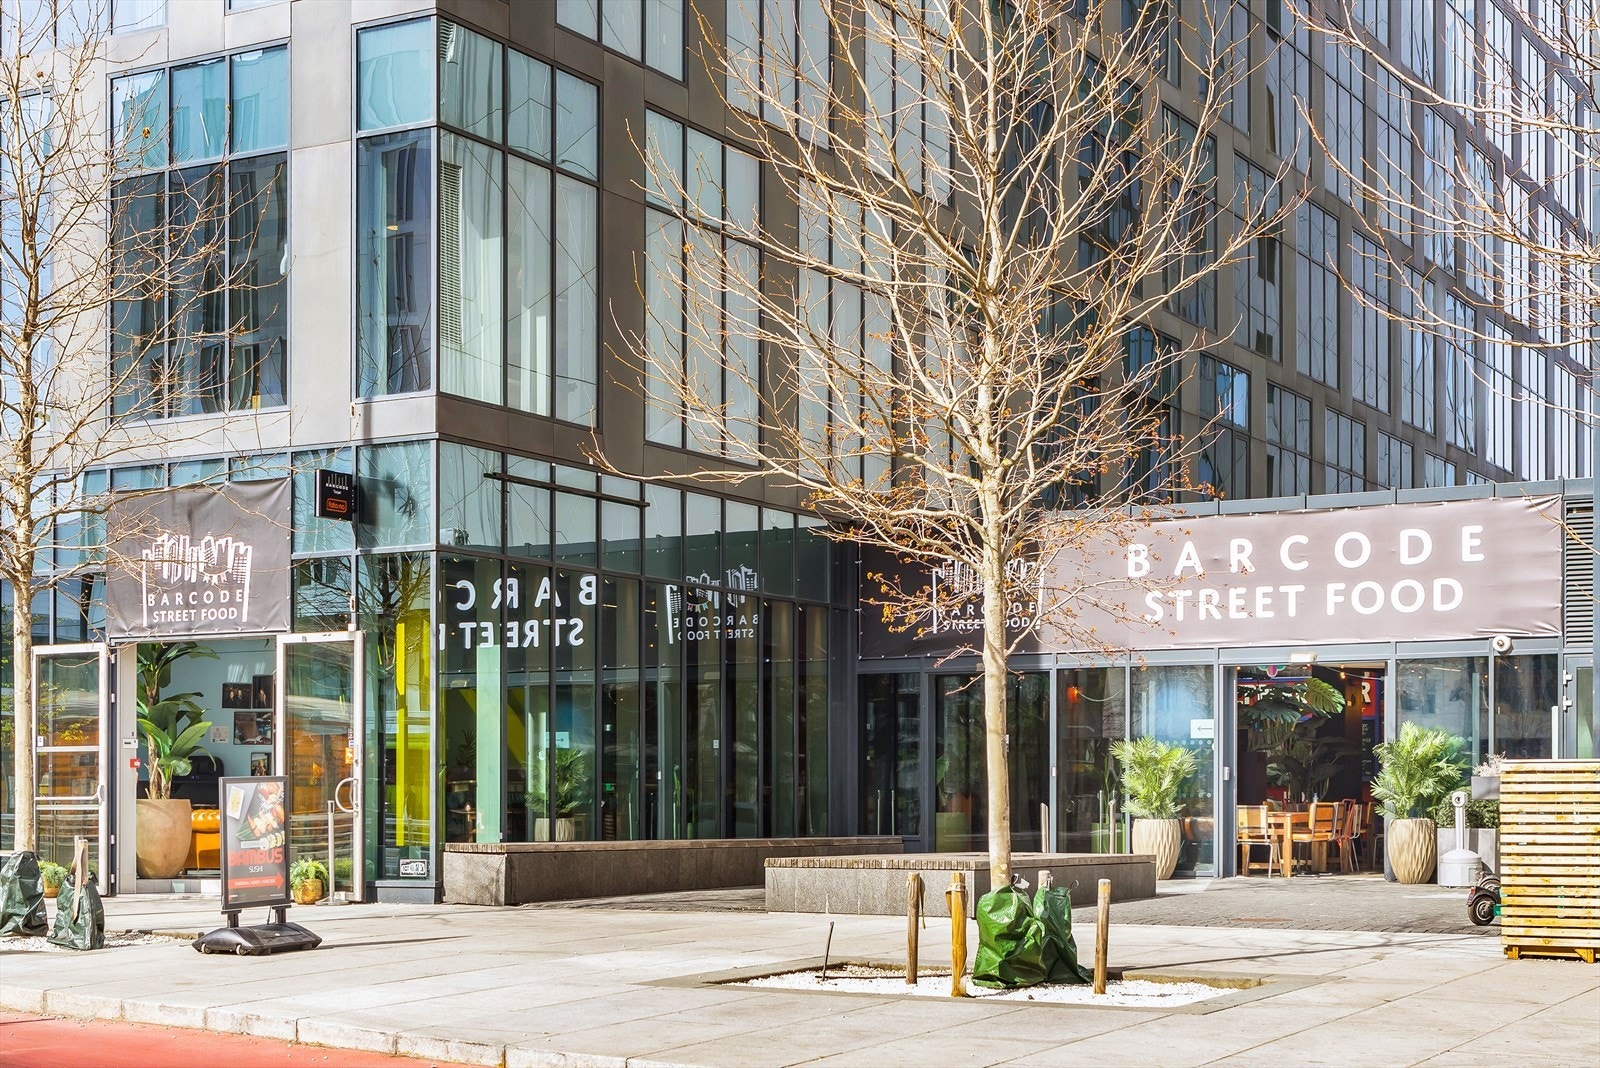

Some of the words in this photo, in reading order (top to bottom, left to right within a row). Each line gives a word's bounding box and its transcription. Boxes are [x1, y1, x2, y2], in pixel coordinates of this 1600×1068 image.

[1126, 525, 1485, 578] BARCODE
[147, 589, 243, 607] BARCODE
[1144, 584, 1306, 622] STREET
[1326, 577, 1464, 617] FOOD
[152, 609, 197, 623] STREET
[201, 607, 238, 620] FOOD
[939, 602, 1036, 616] ARDE
[228, 848, 283, 866] BAMBUS
[248, 865, 263, 873] SUSHI
